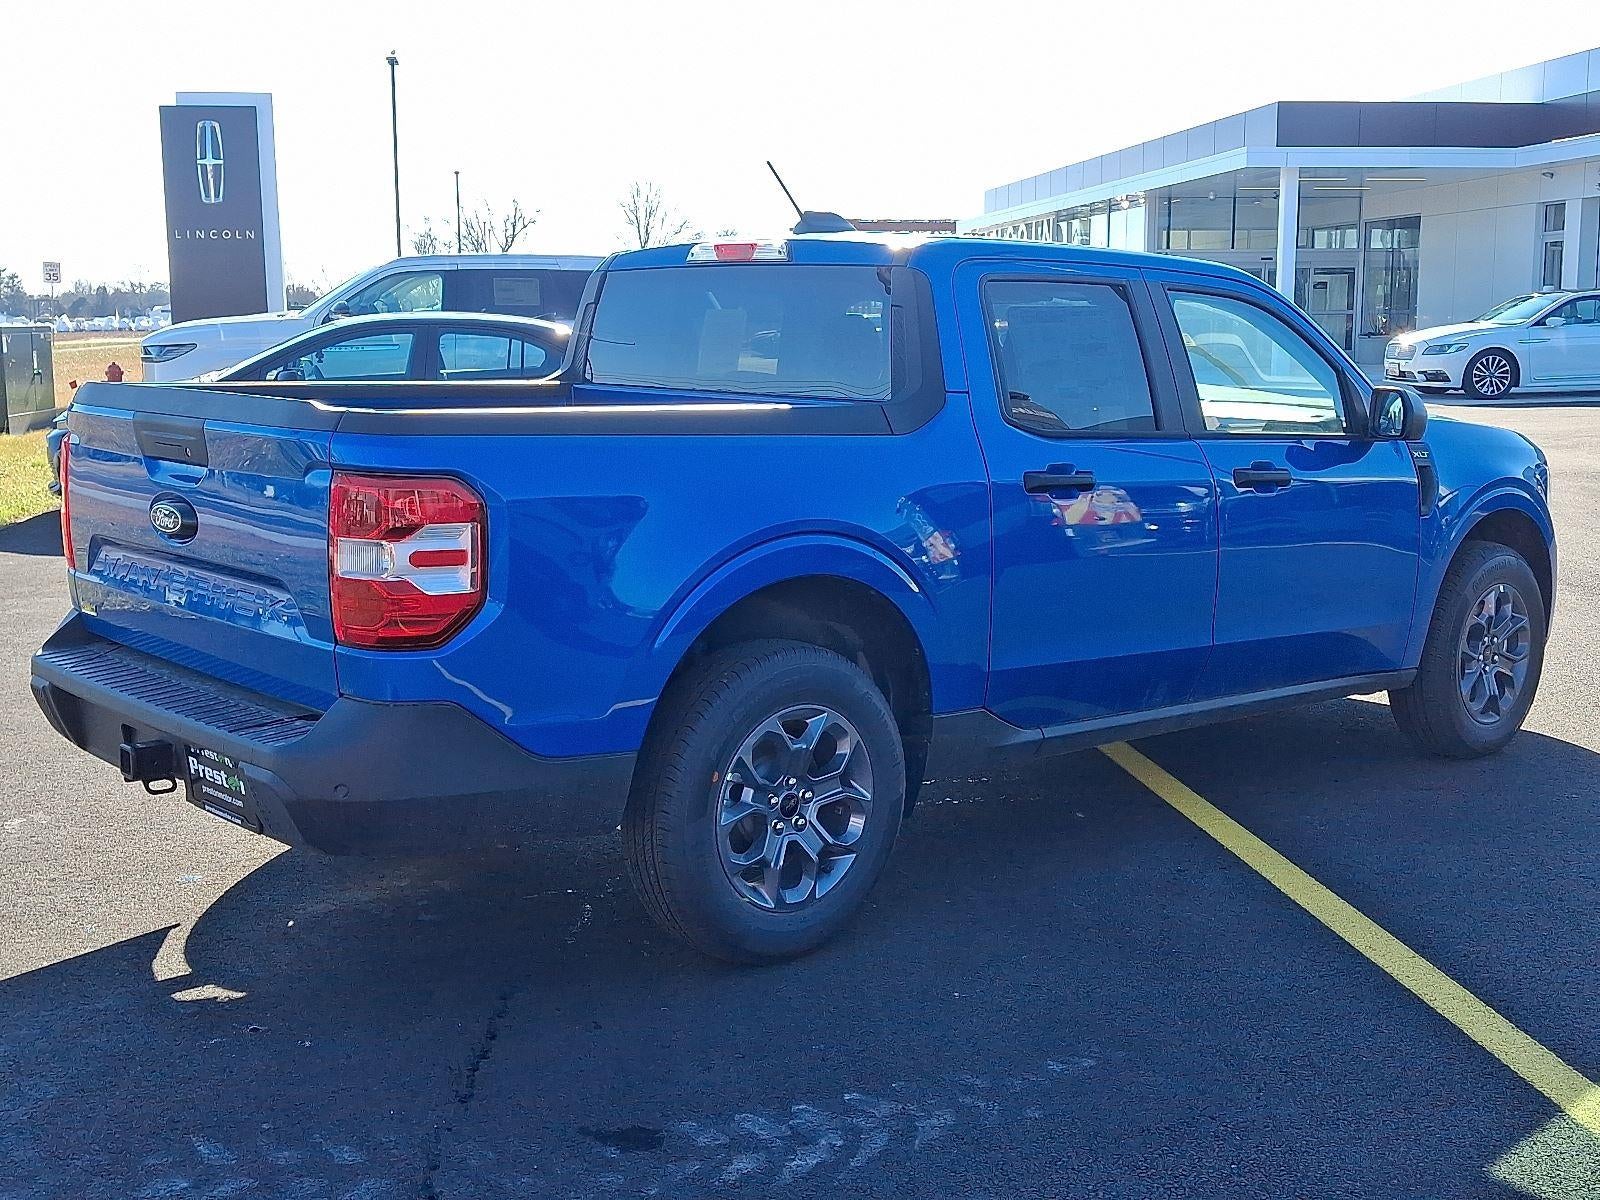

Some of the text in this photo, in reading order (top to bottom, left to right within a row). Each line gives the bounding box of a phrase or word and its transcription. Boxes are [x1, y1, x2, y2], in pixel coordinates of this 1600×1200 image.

[175, 229, 255, 239] LINCOLN
[45, 272, 59, 281] 35
[154, 507, 176, 528] Ford
